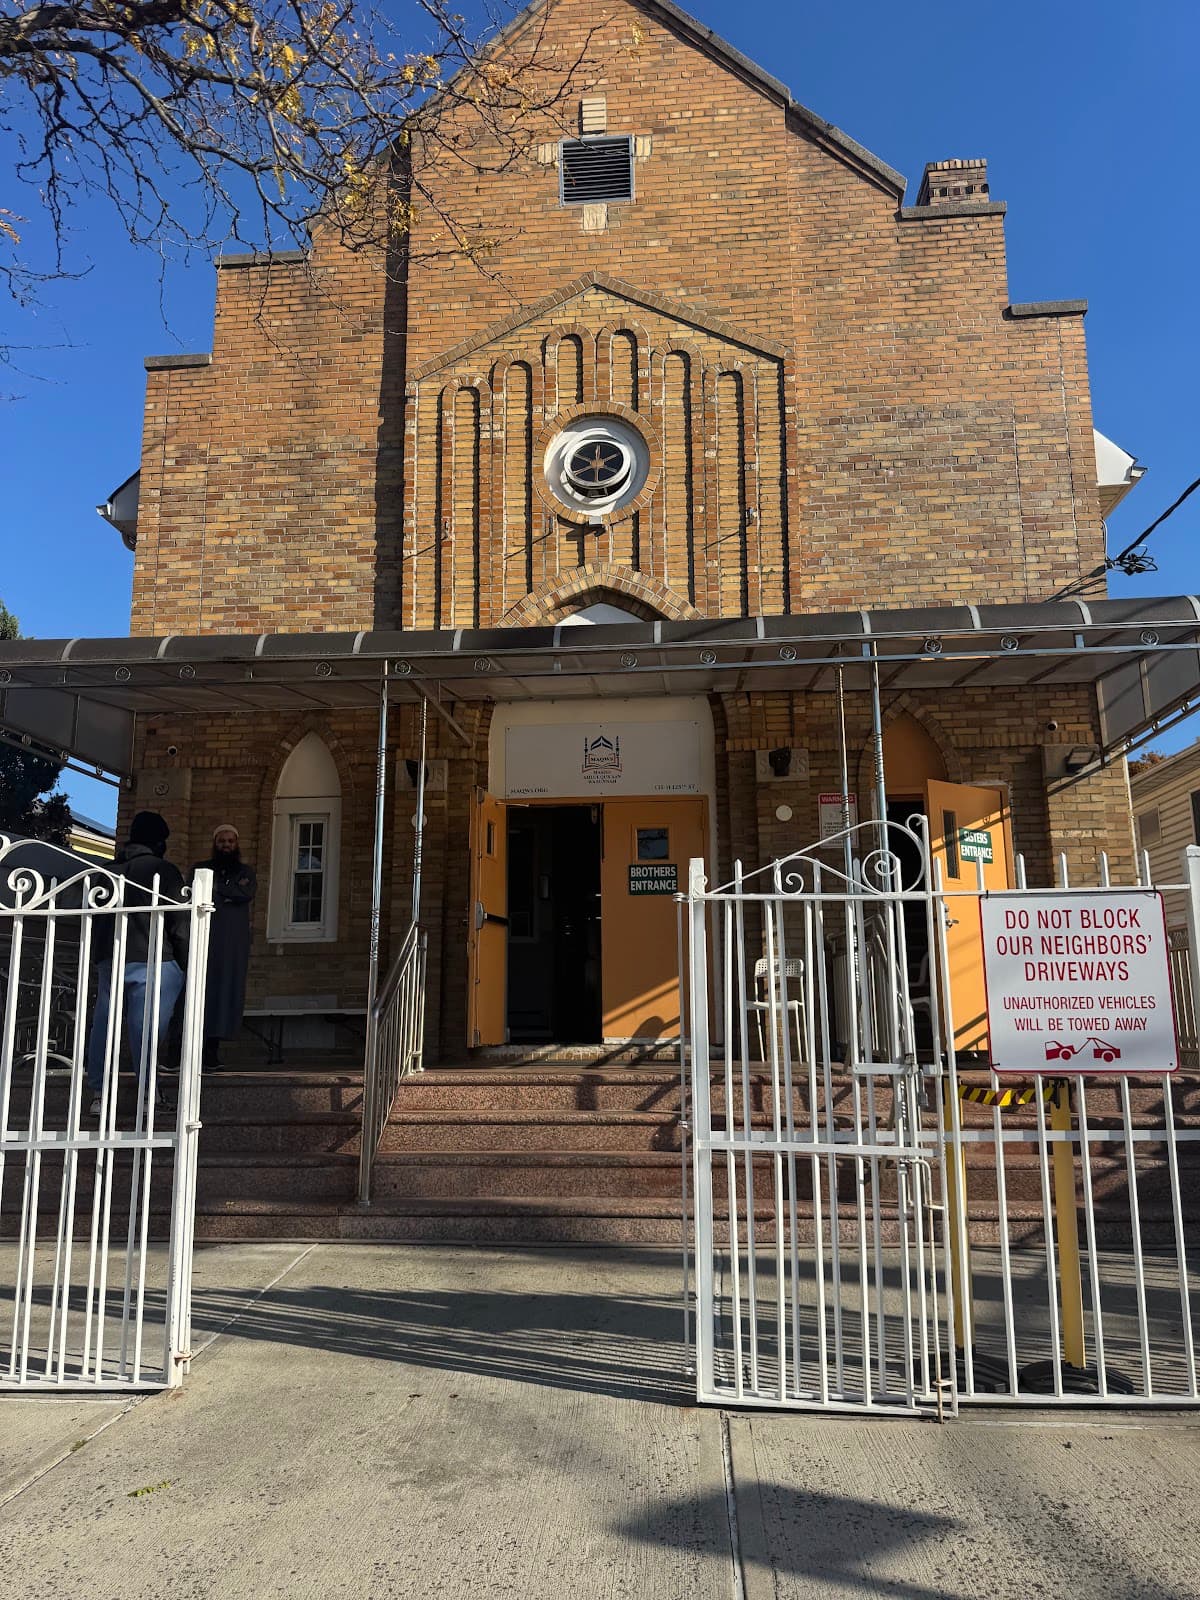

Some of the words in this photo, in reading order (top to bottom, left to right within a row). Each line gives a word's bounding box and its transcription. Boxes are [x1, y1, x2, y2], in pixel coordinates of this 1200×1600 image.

[963, 830, 988, 844] SISTERS
[961, 844, 993, 859] ENTRANCE
[630, 866, 677, 878] BROTHERS
[630, 879, 677, 891] ENTRANCE
[1004, 909, 1030, 929] DO
[1037, 909, 1073, 929] NOT
[1080, 908, 1141, 929] BLOCK
[996, 935, 1034, 956] OUR
[1041, 934, 1152, 955] NEIGHBORS'
[1024, 961, 1129, 981] DRIVEWAYS
[1003, 996, 1094, 1010] UNAUTHORIZED
[1098, 995, 1156, 1009] VEHICLES
[1014, 1018, 1043, 1031] WILL
[1048, 1018, 1064, 1031] BE
[1067, 1017, 1110, 1031] TOWED
[1114, 1017, 1148, 1031] AWAY
